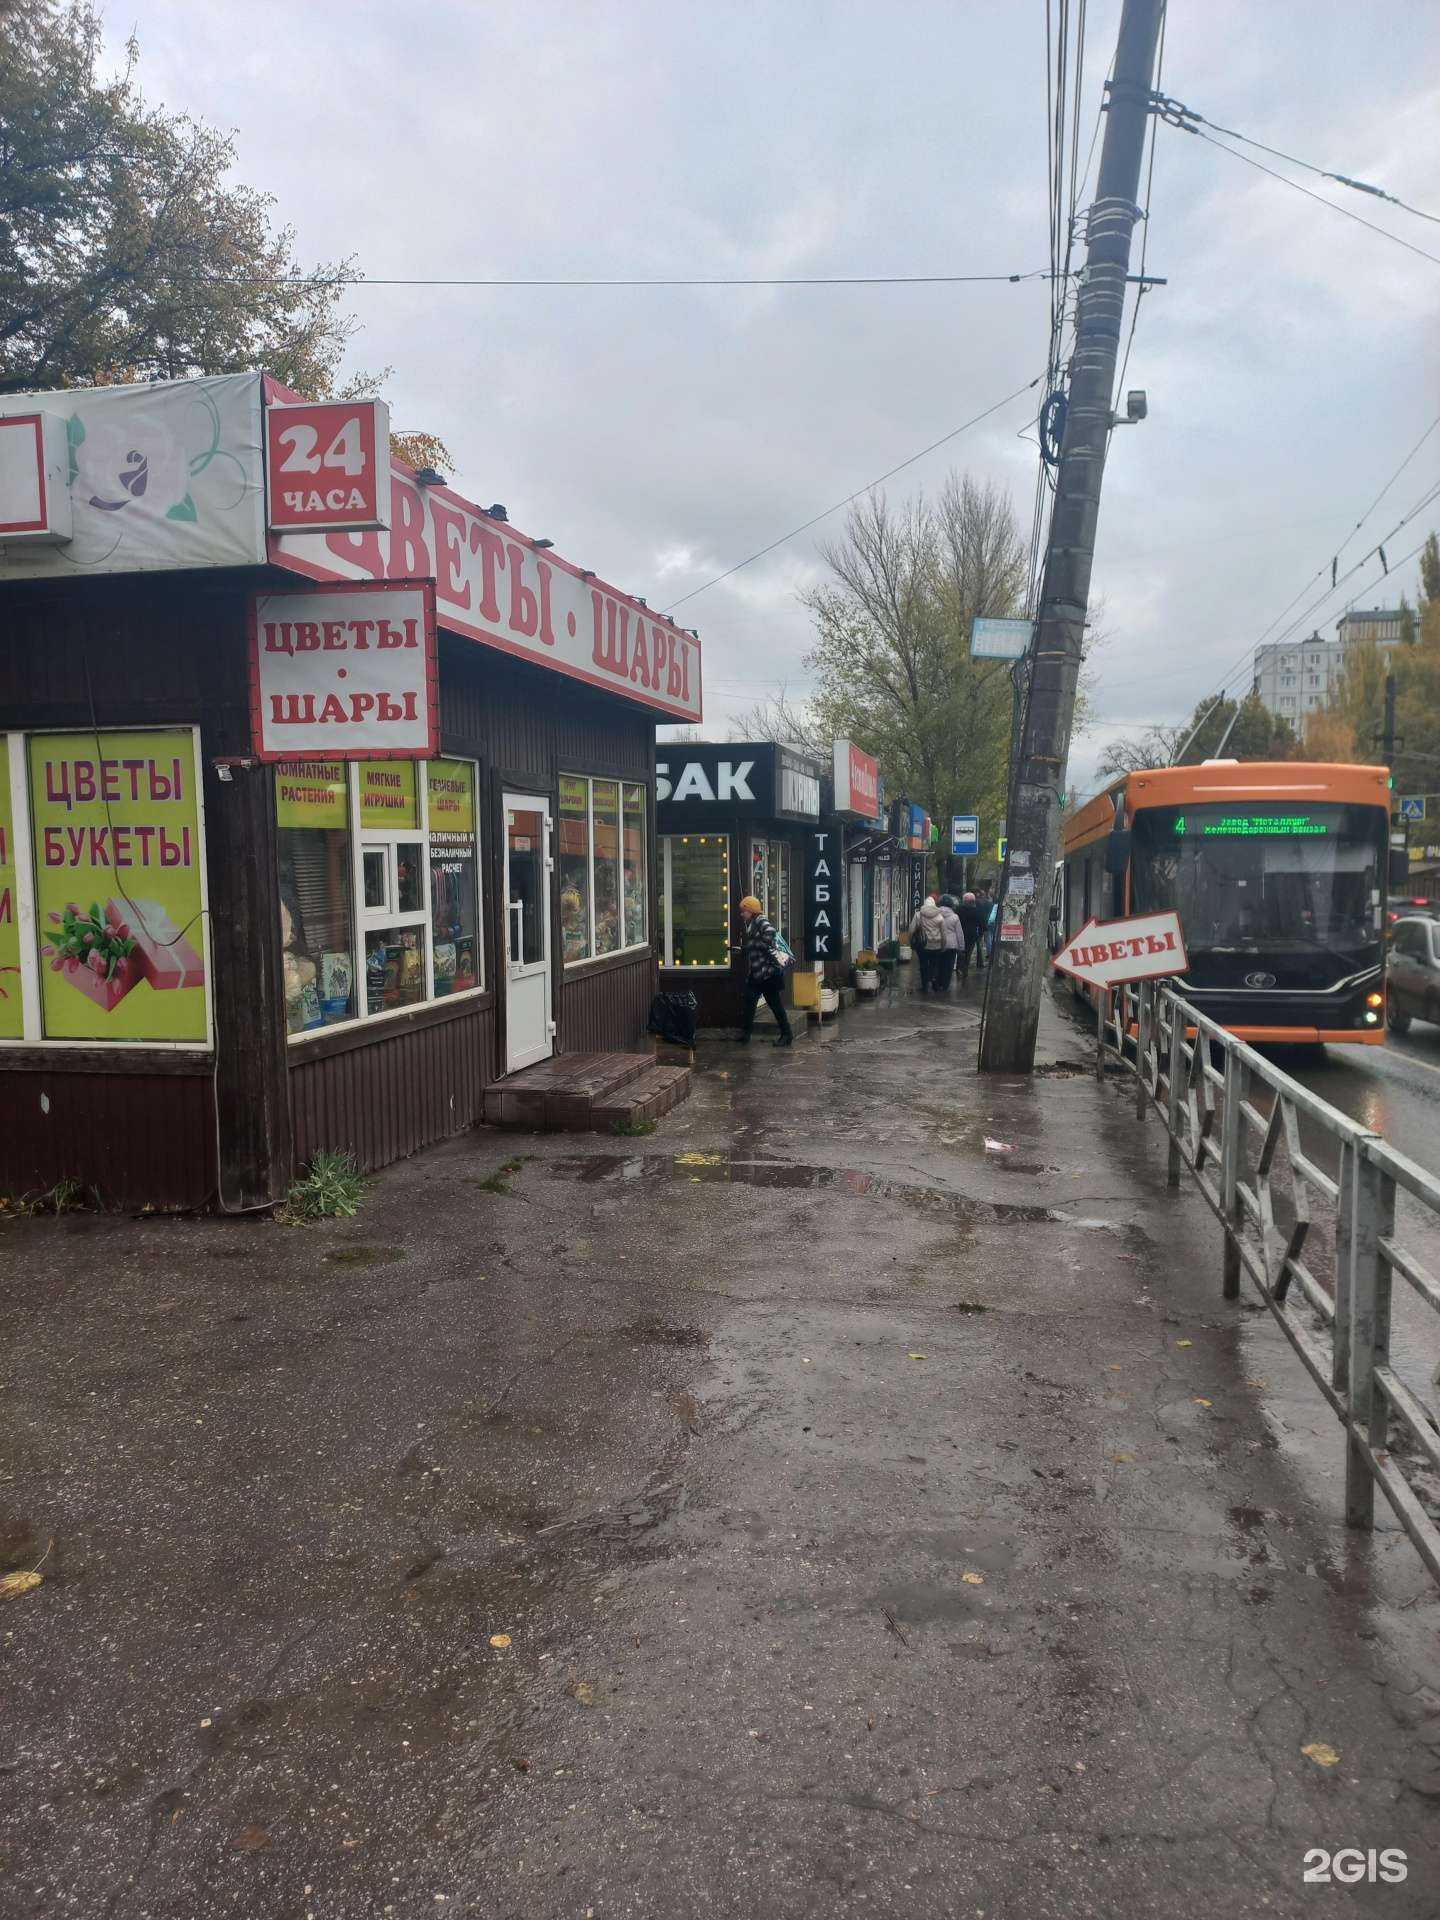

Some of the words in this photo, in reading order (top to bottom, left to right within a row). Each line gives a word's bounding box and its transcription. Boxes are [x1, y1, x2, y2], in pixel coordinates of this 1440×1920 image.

[278, 417, 366, 476] 24
[283, 488, 368, 513] ЧАСА
[263, 618, 418, 657] ЦВЕТЫ
[590, 589, 691, 703] ШАРЫ
[270, 691, 419, 724] ШАРЫ
[45, 759, 182, 811] ЦВЕТЫ
[280, 786, 336, 804] РАСТЕНИЯ
[367, 771, 401, 787] МЯГКИЕ
[364, 792, 405, 808] ИГРУШКИ
[1175, 816, 1186, 834] 4
[43, 826, 192, 867] БУКЕТЫ
[441, 863, 463, 873] РАСЧЕТ
[814, 833, 831, 953] ТАБАК
[1069, 932, 1177, 967] ЦВЕТЫ
